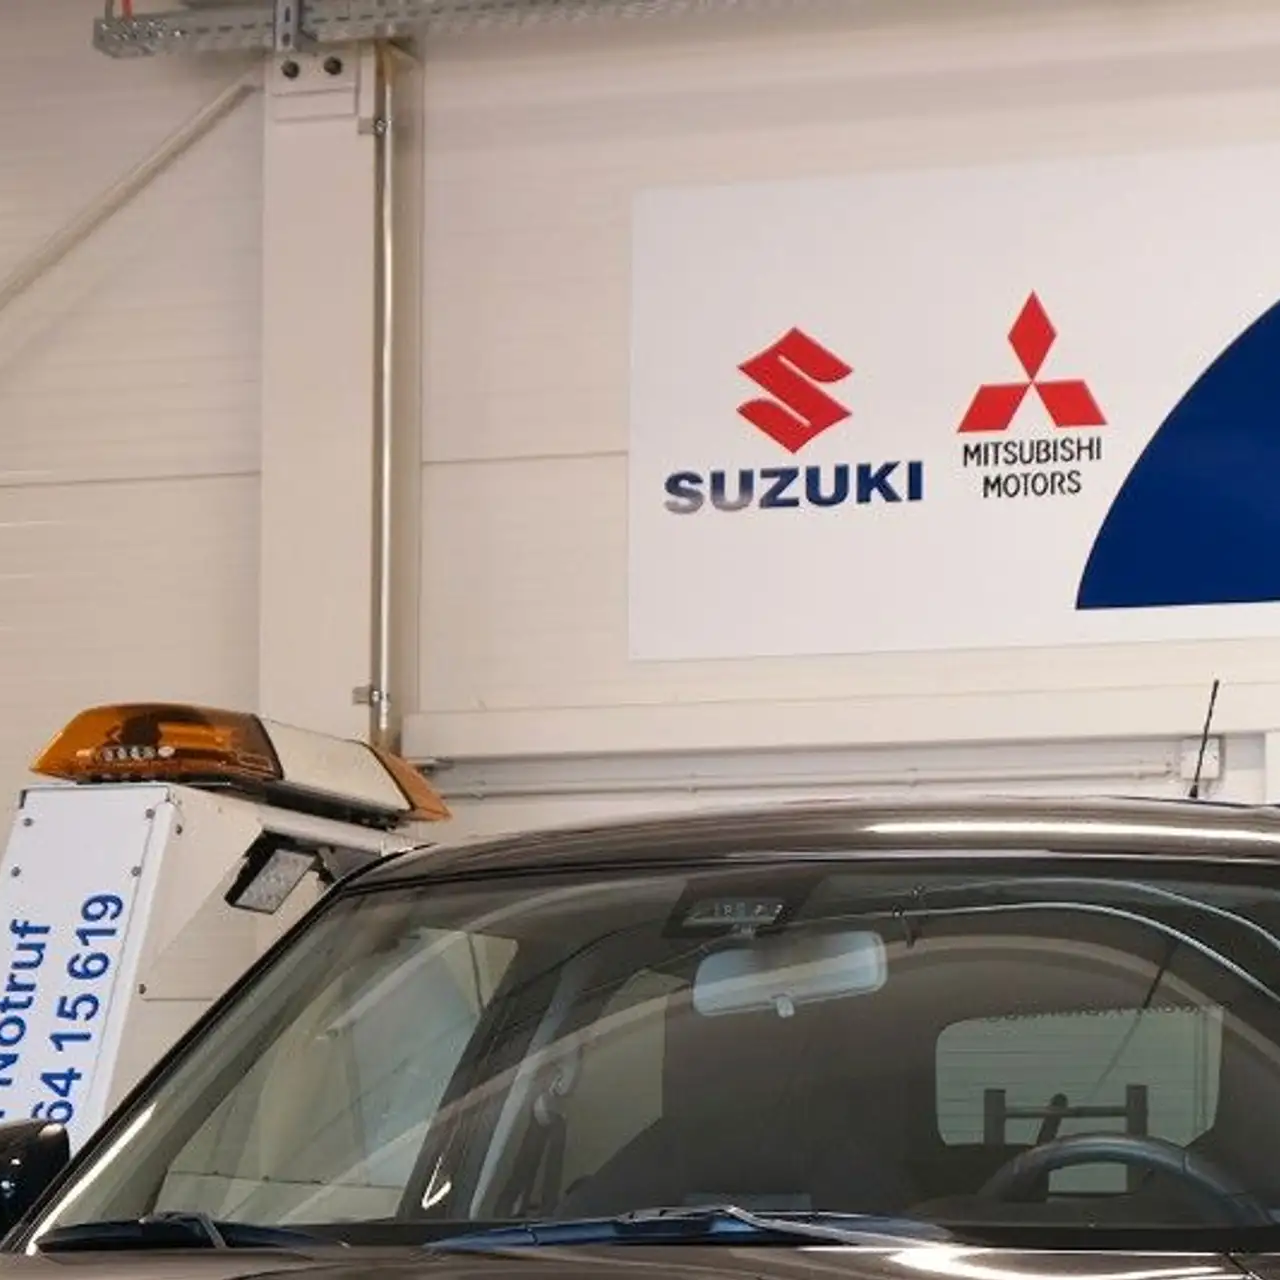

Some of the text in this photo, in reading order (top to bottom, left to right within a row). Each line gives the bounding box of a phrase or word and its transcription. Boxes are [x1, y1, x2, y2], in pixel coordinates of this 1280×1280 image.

[963, 437, 1103, 469] MITSUBISHI
[664, 460, 924, 514] SUZUKI
[983, 470, 1083, 498] MOTORS
[67, 893, 124, 981] 619
[50, 993, 101, 1052] 15
